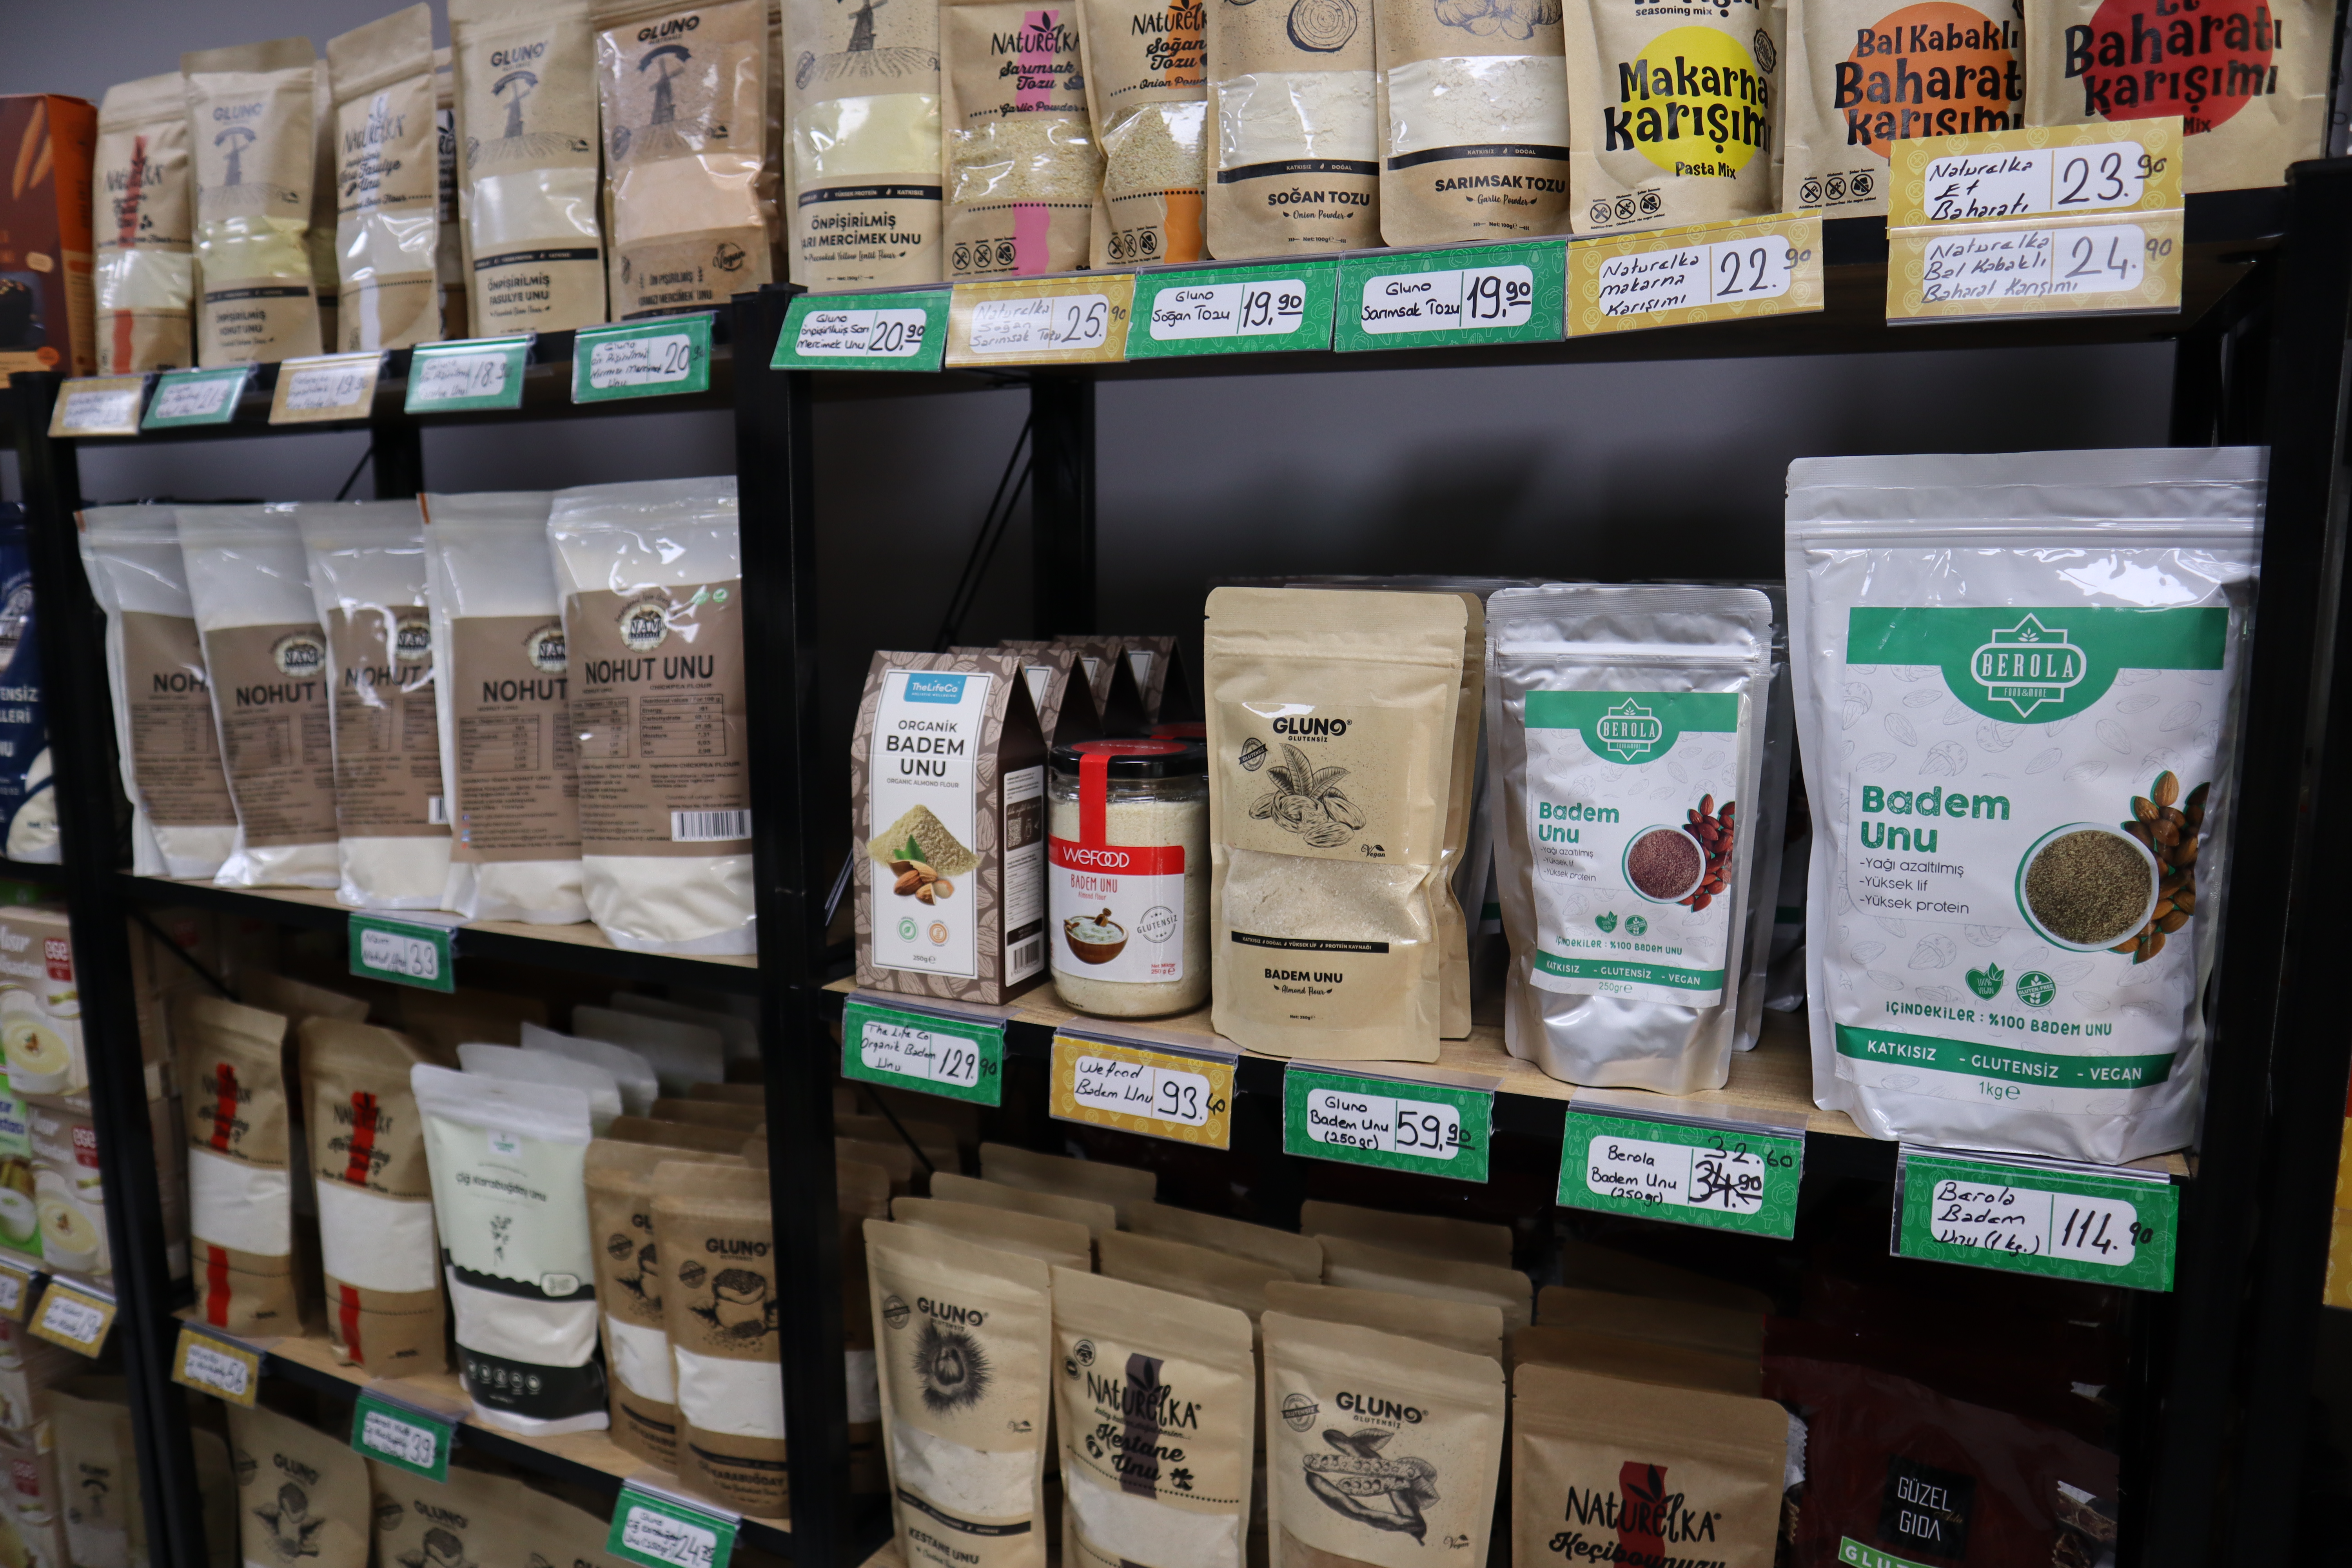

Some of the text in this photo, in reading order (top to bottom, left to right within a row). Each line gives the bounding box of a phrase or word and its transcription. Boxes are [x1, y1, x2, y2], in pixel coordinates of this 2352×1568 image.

[1635, 5, 1691, 16] seasoning
[1693, 7, 1713, 16] mix
[637, 16, 699, 42] GLUNO
[1857, 20, 2019, 58] Bal Kabaklı
[1146, 38, 1206, 59] Soğan
[2065, 6, 2283, 79] Baharatı
[491, 42, 544, 68] GLUNO
[1151, 54, 1197, 71] Tozu
[1000, 61, 1075, 77] Sarımsak
[1016, 75, 1056, 91] Tozu
[1140, 78, 1171, 90] Onion
[1619, 56, 1769, 109] Makarna
[1834, 58, 2023, 109] Baharat
[1000, 100, 1078, 117] Garlic Powder
[2184, 117, 2212, 134] Mix
[1331, 163, 1352, 171] DOĞAL
[1675, 161, 1737, 180] Pasta Mix
[1929, 156, 2033, 182] Naturelka
[1434, 176, 1566, 194] SARIMSAK TOZU
[1935, 180, 1979, 201] Et
[1268, 187, 1370, 207] SOĞAN TOZU
[1477, 193, 1530, 207] Garlic Powder
[1931, 192, 2029, 221] Baharatı
[811, 211, 896, 231] ÖNPİŞİRİLMİŞ
[1293, 209, 1346, 220] Onion Powder
[819, 230, 921, 246] MERCİMEK UNU
[1931, 230, 2050, 261] Naturelka
[1602, 252, 1700, 279] Naturelka
[1923, 252, 2047, 281] Bal Kabaklı
[526, 290, 549, 301] UNU
[1176, 290, 1214, 301] Gluno
[1386, 281, 1432, 296] Gluno
[1921, 279, 1996, 304] Baharat
[1152, 305, 1230, 327] Soğan Tozu
[1426, 298, 1460, 315] Tozu
[816, 314, 848, 323] Gluno
[796, 336, 865, 350] Mercimek Unu
[585, 655, 713, 684] NOHUT UNU
[1981, 653, 2074, 679] BEROLA
[236, 681, 315, 706] NOHUT
[483, 678, 568, 704] NOHUT
[912, 679, 958, 693] TheLifeCo
[2004, 687, 2048, 698] FOOD&MORE
[898, 720, 958, 733] ORGANİK
[1273, 717, 1347, 736] GLUNO
[1603, 721, 1656, 739] BEROLA
[886, 735, 965, 756] BADEM
[900, 757, 946, 777] UNU
[886, 777, 913, 786] ORGANIC
[913, 779, 939, 788] ALMOND
[1539, 801, 1620, 824] Badem
[1862, 785, 2010, 821] Badem
[1539, 824, 1580, 844] Unu
[1860, 821, 1938, 853] Unu
[1361, 844, 1385, 858] Vegan
[1559, 847, 1594, 859] azaltılmış
[1569, 871, 1597, 883] protein
[1899, 860, 1965, 878] azaltılmış
[1071, 873, 1118, 893] BADEM UNU
[1916, 878, 1929, 892] lif
[1916, 897, 1970, 916] protein
[1137, 914, 1178, 935] GLUTENSİZ
[1610, 941, 1682, 956] %100 UNU
[1265, 968, 1343, 984] BADEM UNU
[1546, 960, 1700, 985] KATKISIZ GLUTENSİZ VEGAN
[1281, 984, 1327, 996] Almond Flour
[1599, 981, 1623, 995] 250gr
[1989, 1013, 2113, 1037] %100 UNU
[860, 1037, 900, 1053] Organik
[1867, 1040, 2143, 1082] KATKISIZ GLUTENSİZ VEGAN
[1074, 1078, 1154, 1104] Badem Unu
[1978, 1081, 2004, 1100] 1kg
[1325, 1096, 1368, 1112] Gluno
[1310, 1109, 1389, 1133] Badem Unu
[1608, 1145, 1655, 1167] Berola
[1591, 1167, 1677, 1190] Badem Unu
[1937, 1181, 2015, 1206] Berola
[1937, 1203, 2025, 1225] Badem
[706, 1238, 768, 1257] GLUNO
[1933, 1229, 1978, 1247] Unu
[917, 1296, 983, 1327] GLUNO
[1336, 1392, 1423, 1425] GLUNO
[1353, 1415, 1401, 1429] GLUTENSİZ
[1096, 1423, 1186, 1463] Kestane
[1111, 1454, 1161, 1481] Unu
[1897, 1477, 1952, 1512] GÜZEL
[1899, 1510, 1941, 1542] GIDA
[1444, 1535, 1469, 1550] Vegan
[952, 1549, 979, 1564] UNU
